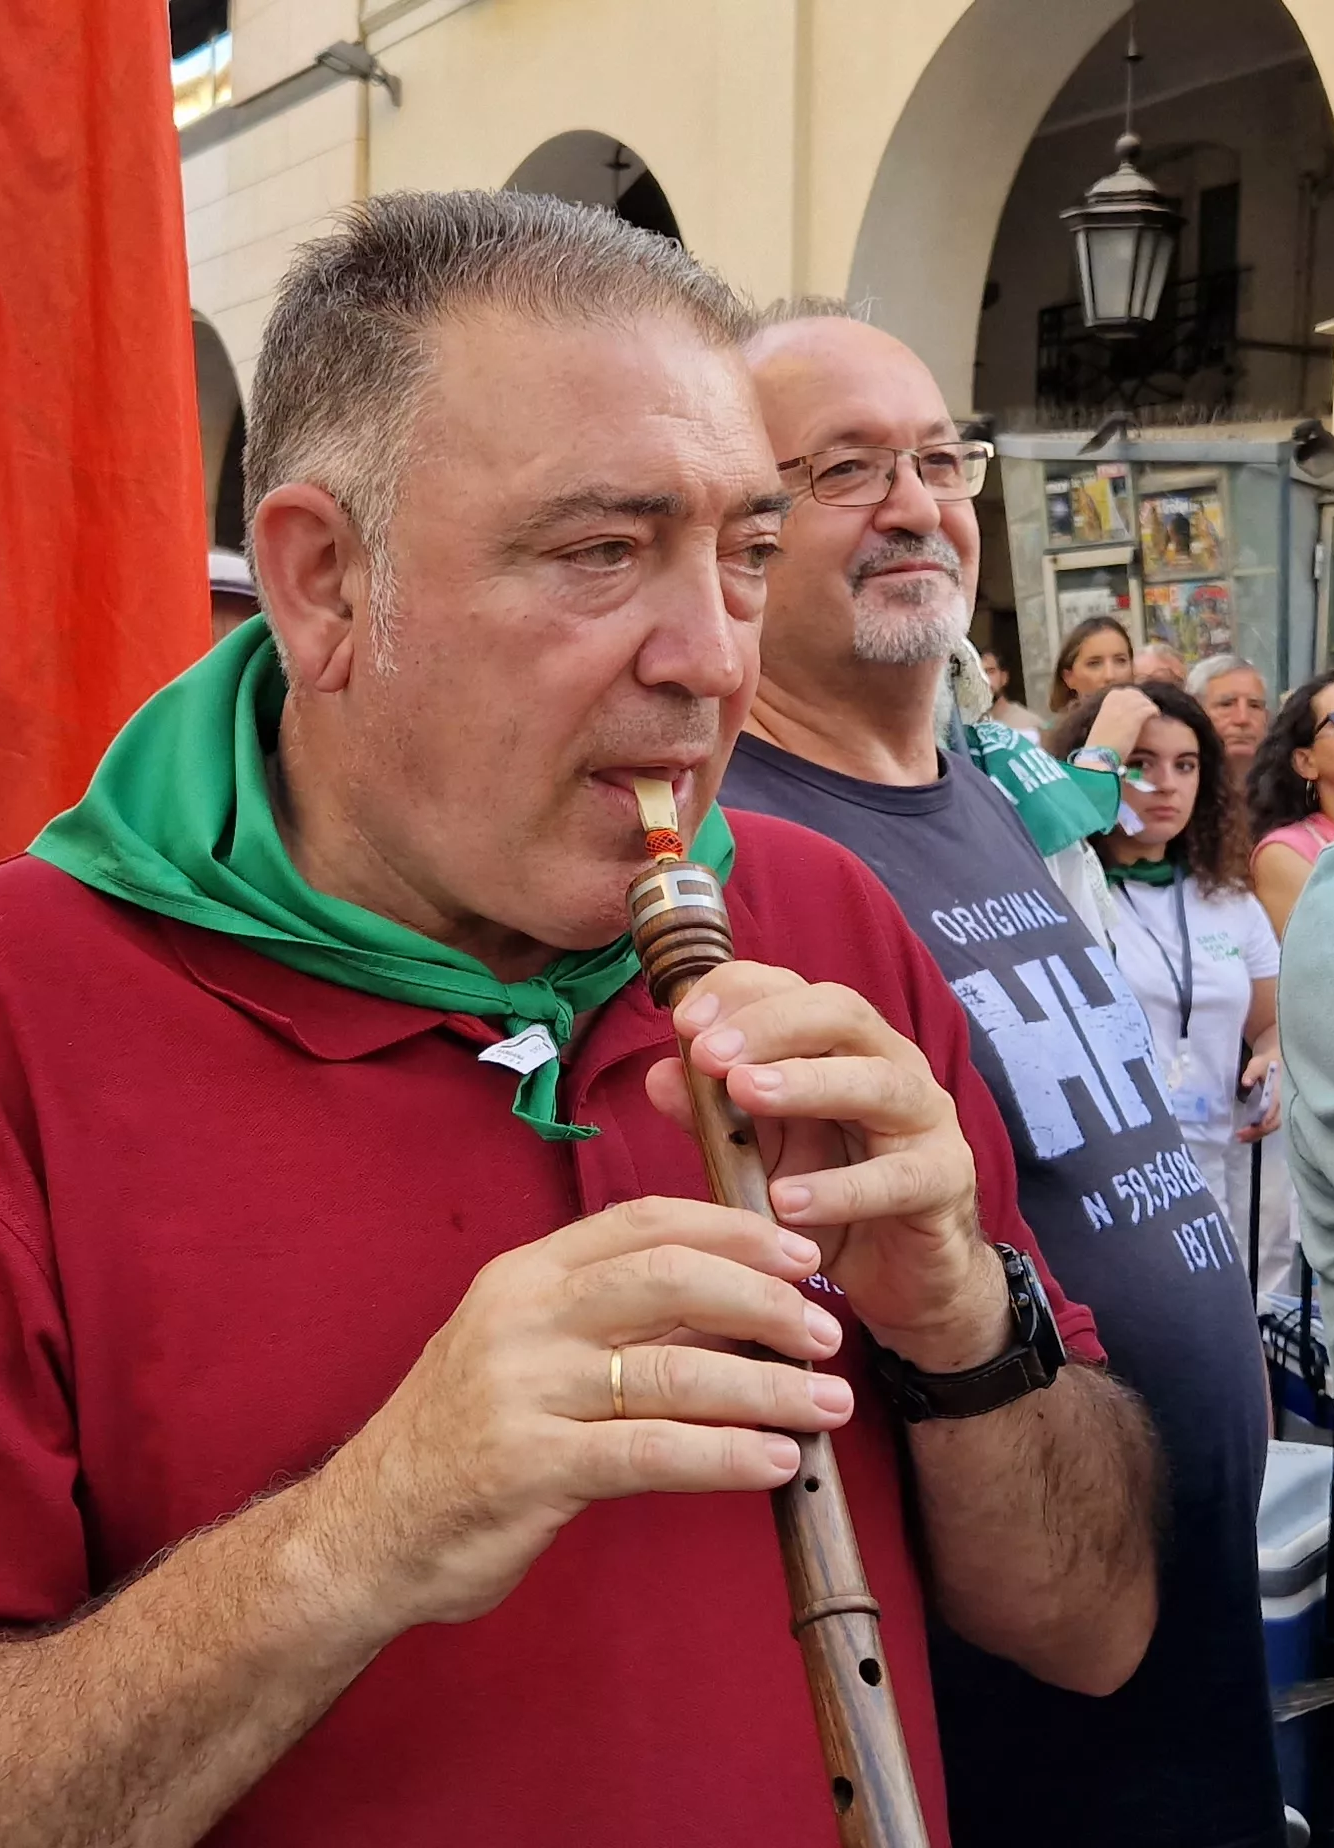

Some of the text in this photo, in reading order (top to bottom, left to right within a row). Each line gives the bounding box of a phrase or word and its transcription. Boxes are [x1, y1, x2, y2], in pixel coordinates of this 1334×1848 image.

[931, 889, 1068, 945] ORIGINAL
[1081, 1191, 1114, 1231] N
[1172, 1212, 1235, 1273] 1877
